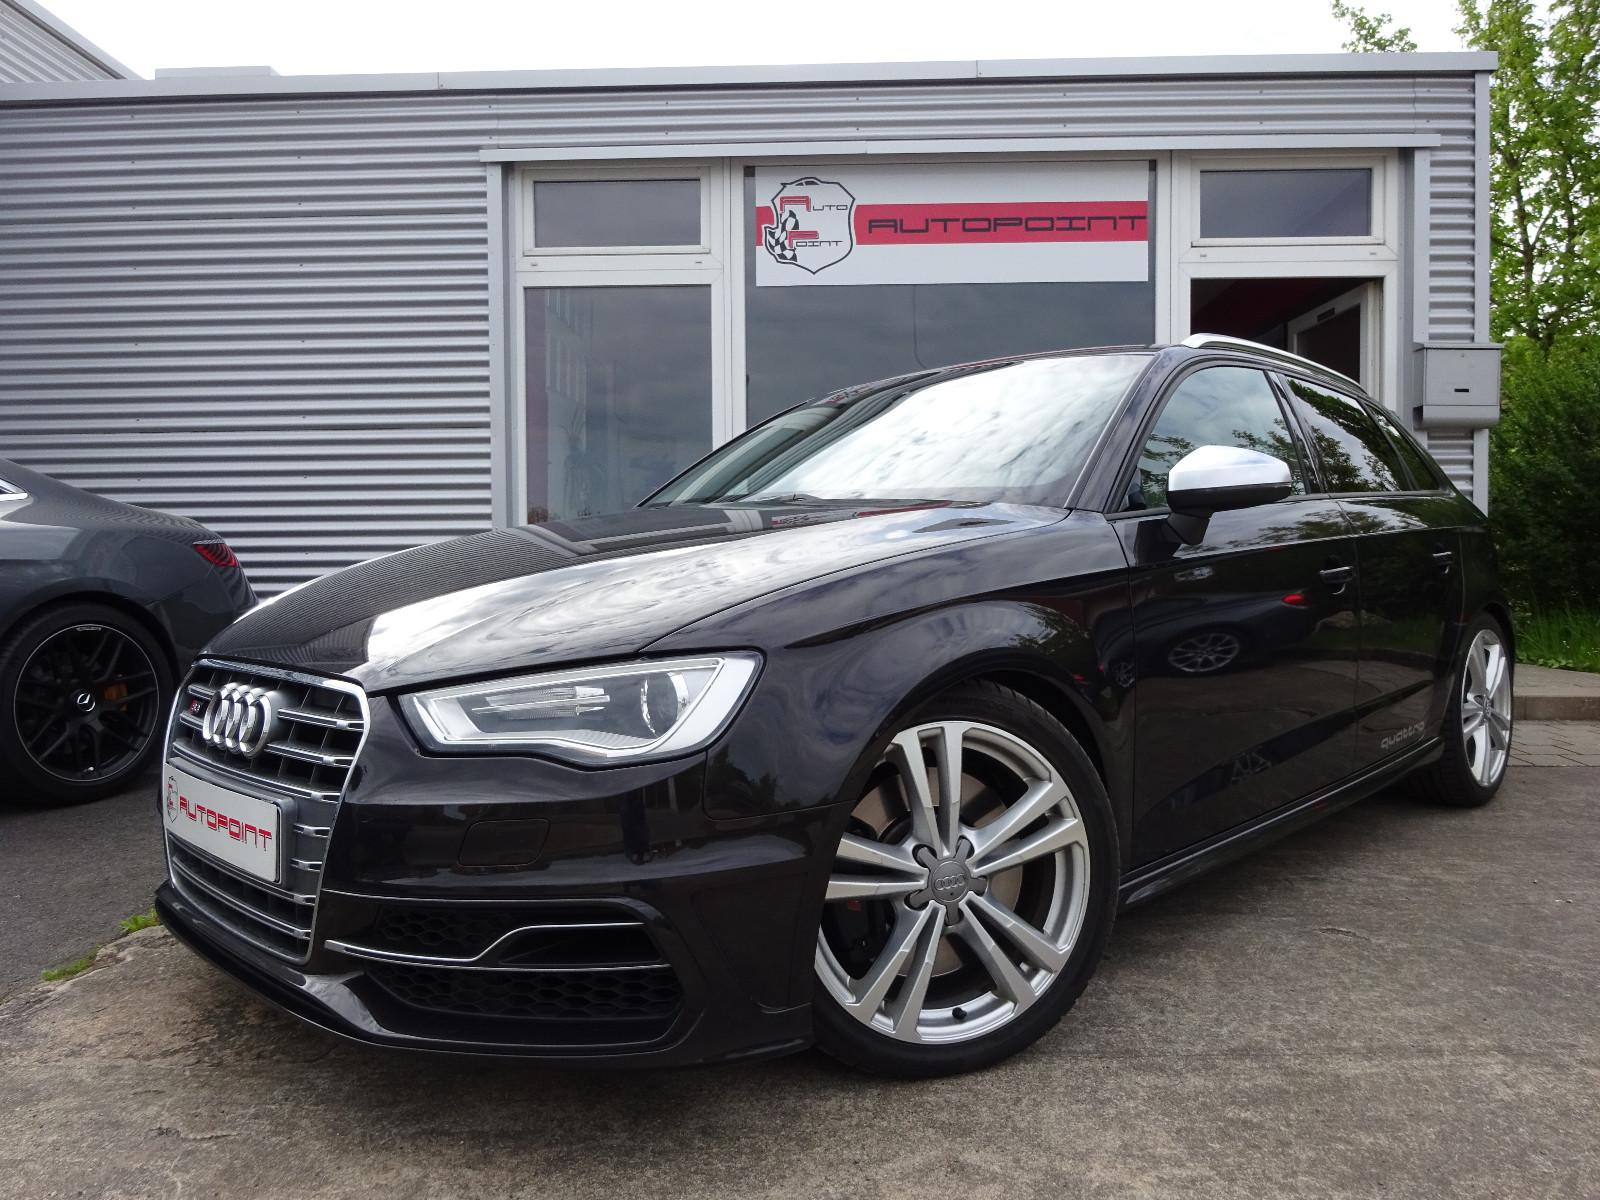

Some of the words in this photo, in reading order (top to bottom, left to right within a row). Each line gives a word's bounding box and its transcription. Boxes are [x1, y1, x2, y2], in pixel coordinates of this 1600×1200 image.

[868, 215, 1147, 234] AUTOPOINT
[1381, 721, 1425, 749] quattro
[179, 795, 272, 851] AUTOPOINT
